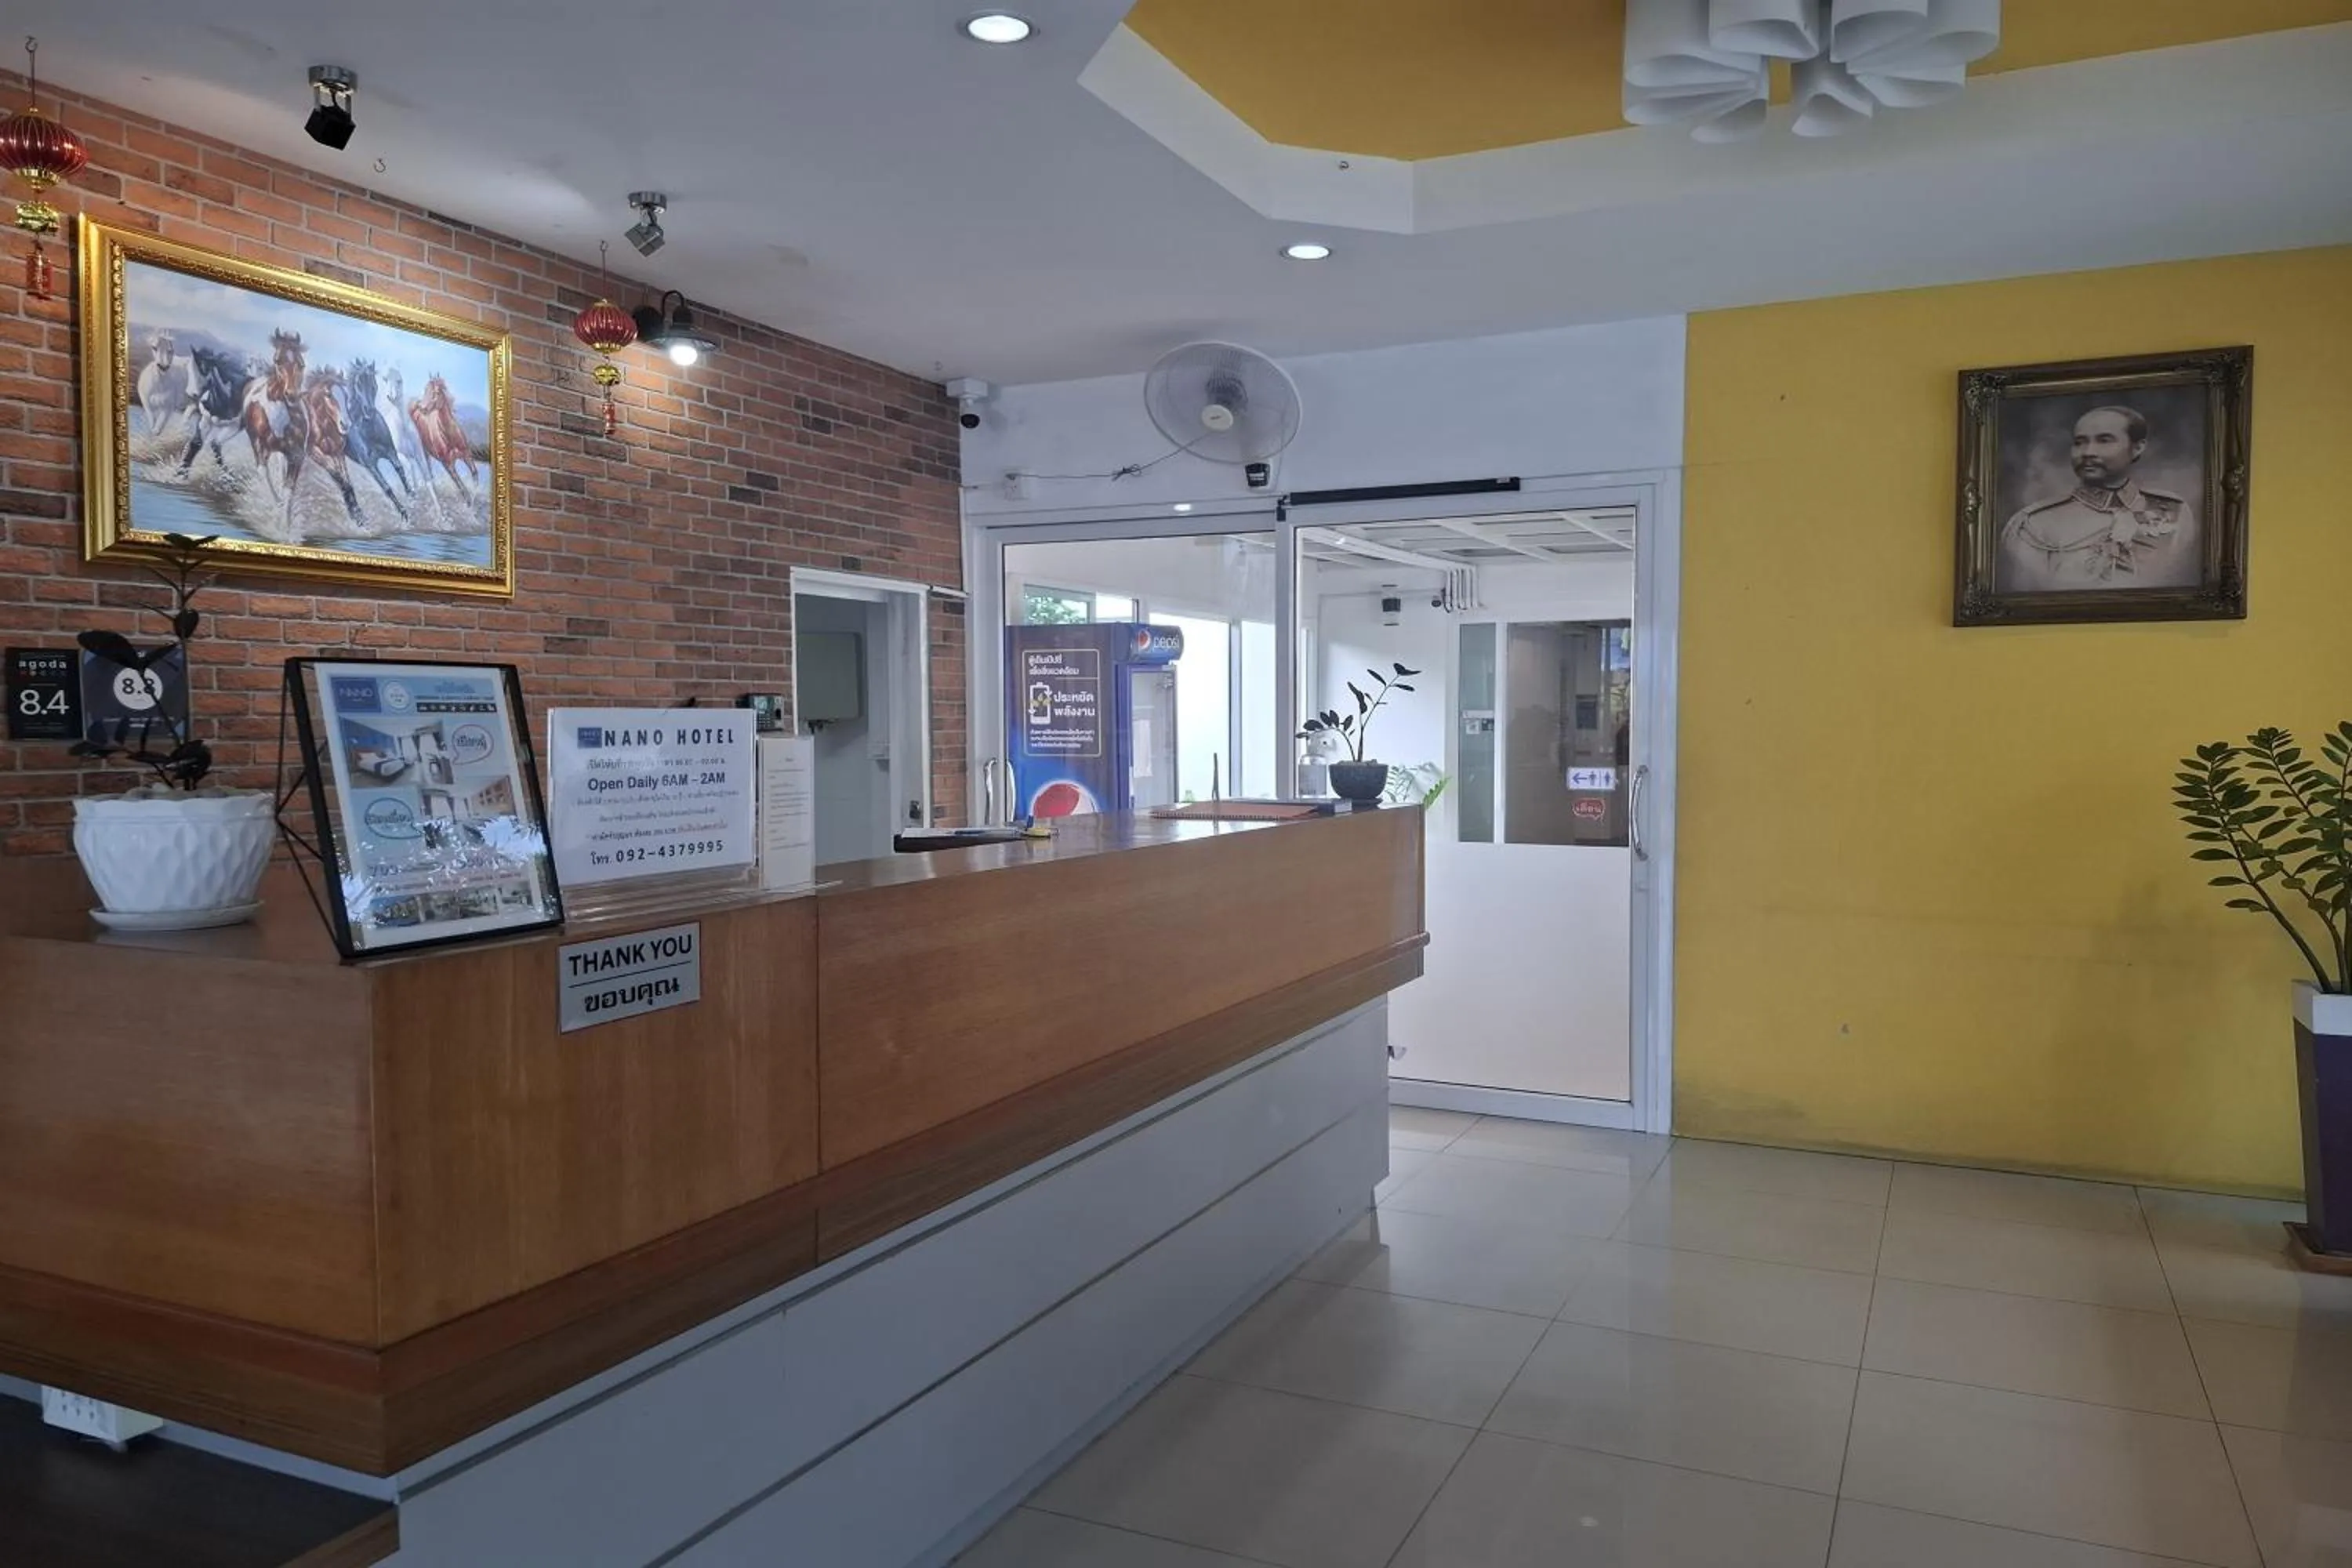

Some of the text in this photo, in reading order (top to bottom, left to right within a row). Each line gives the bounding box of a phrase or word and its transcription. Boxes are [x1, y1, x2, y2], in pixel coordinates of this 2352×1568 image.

[18, 659, 67, 670] agoda
[19, 689, 70, 715] 8.4
[1053, 691, 1094, 702] ประหยัด
[1053, 706, 1095, 716] พลังงาน
[604, 728, 663, 747] NANO
[677, 728, 735, 746] HOTEL
[588, 777, 624, 793] Open
[627, 775, 659, 790] Daily
[662, 773, 688, 786] 6AM
[700, 771, 725, 785] 2AM
[615, 840, 724, 863] 092-4379995
[568, 934, 692, 977] THANK YOU
[583, 977, 681, 1013] ขอบคุณ
